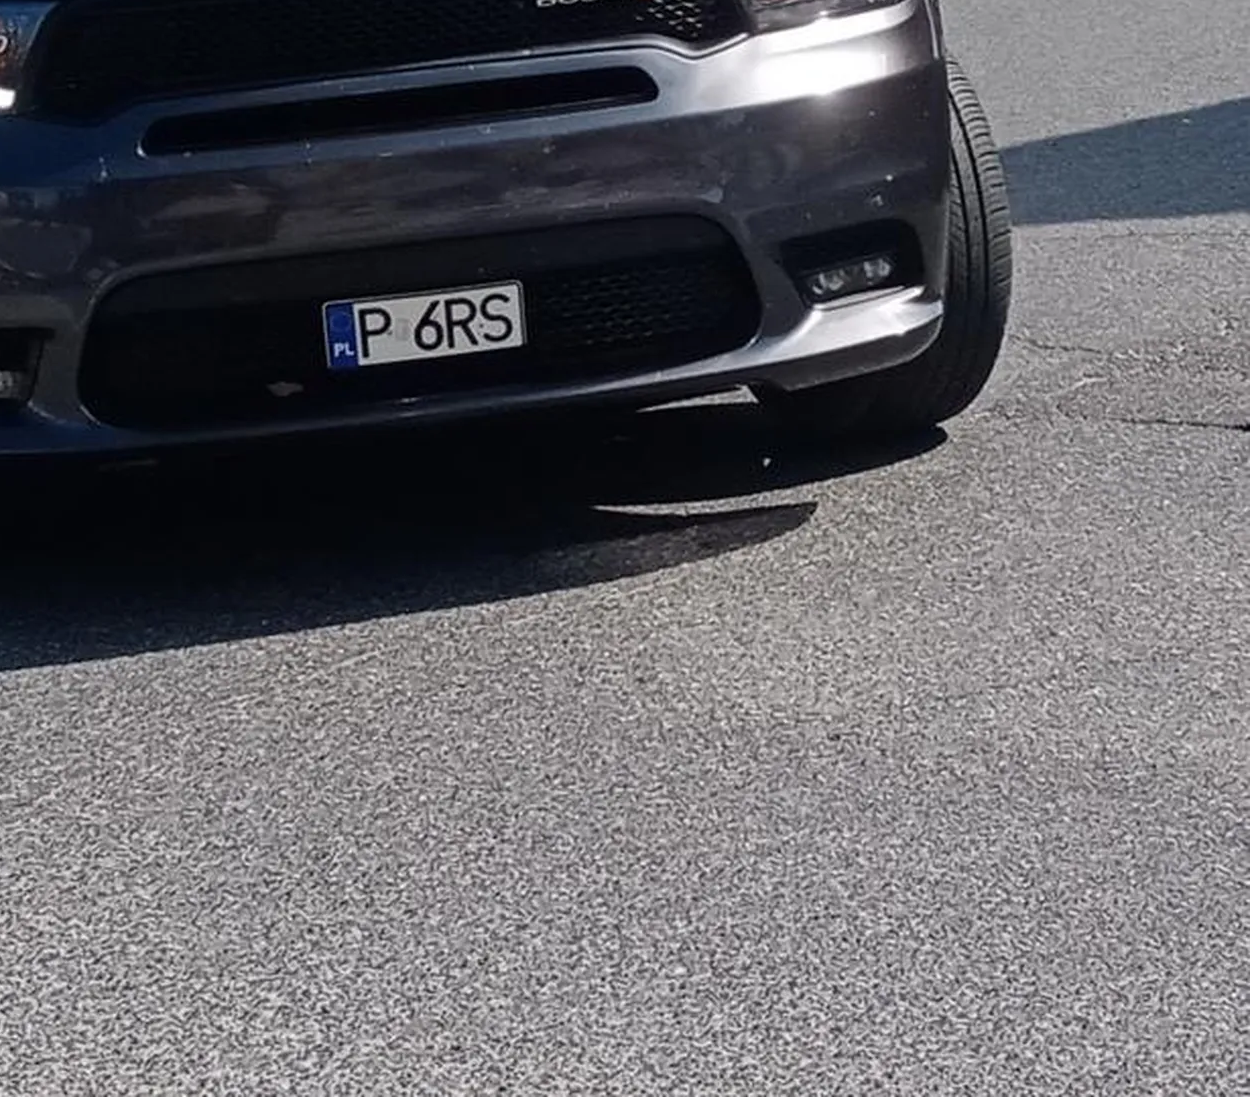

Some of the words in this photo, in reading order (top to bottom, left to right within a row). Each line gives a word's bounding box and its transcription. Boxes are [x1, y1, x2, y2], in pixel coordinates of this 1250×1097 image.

[357, 307, 392, 359] P
[413, 293, 514, 351] 6RS
[333, 342, 355, 358] PL
